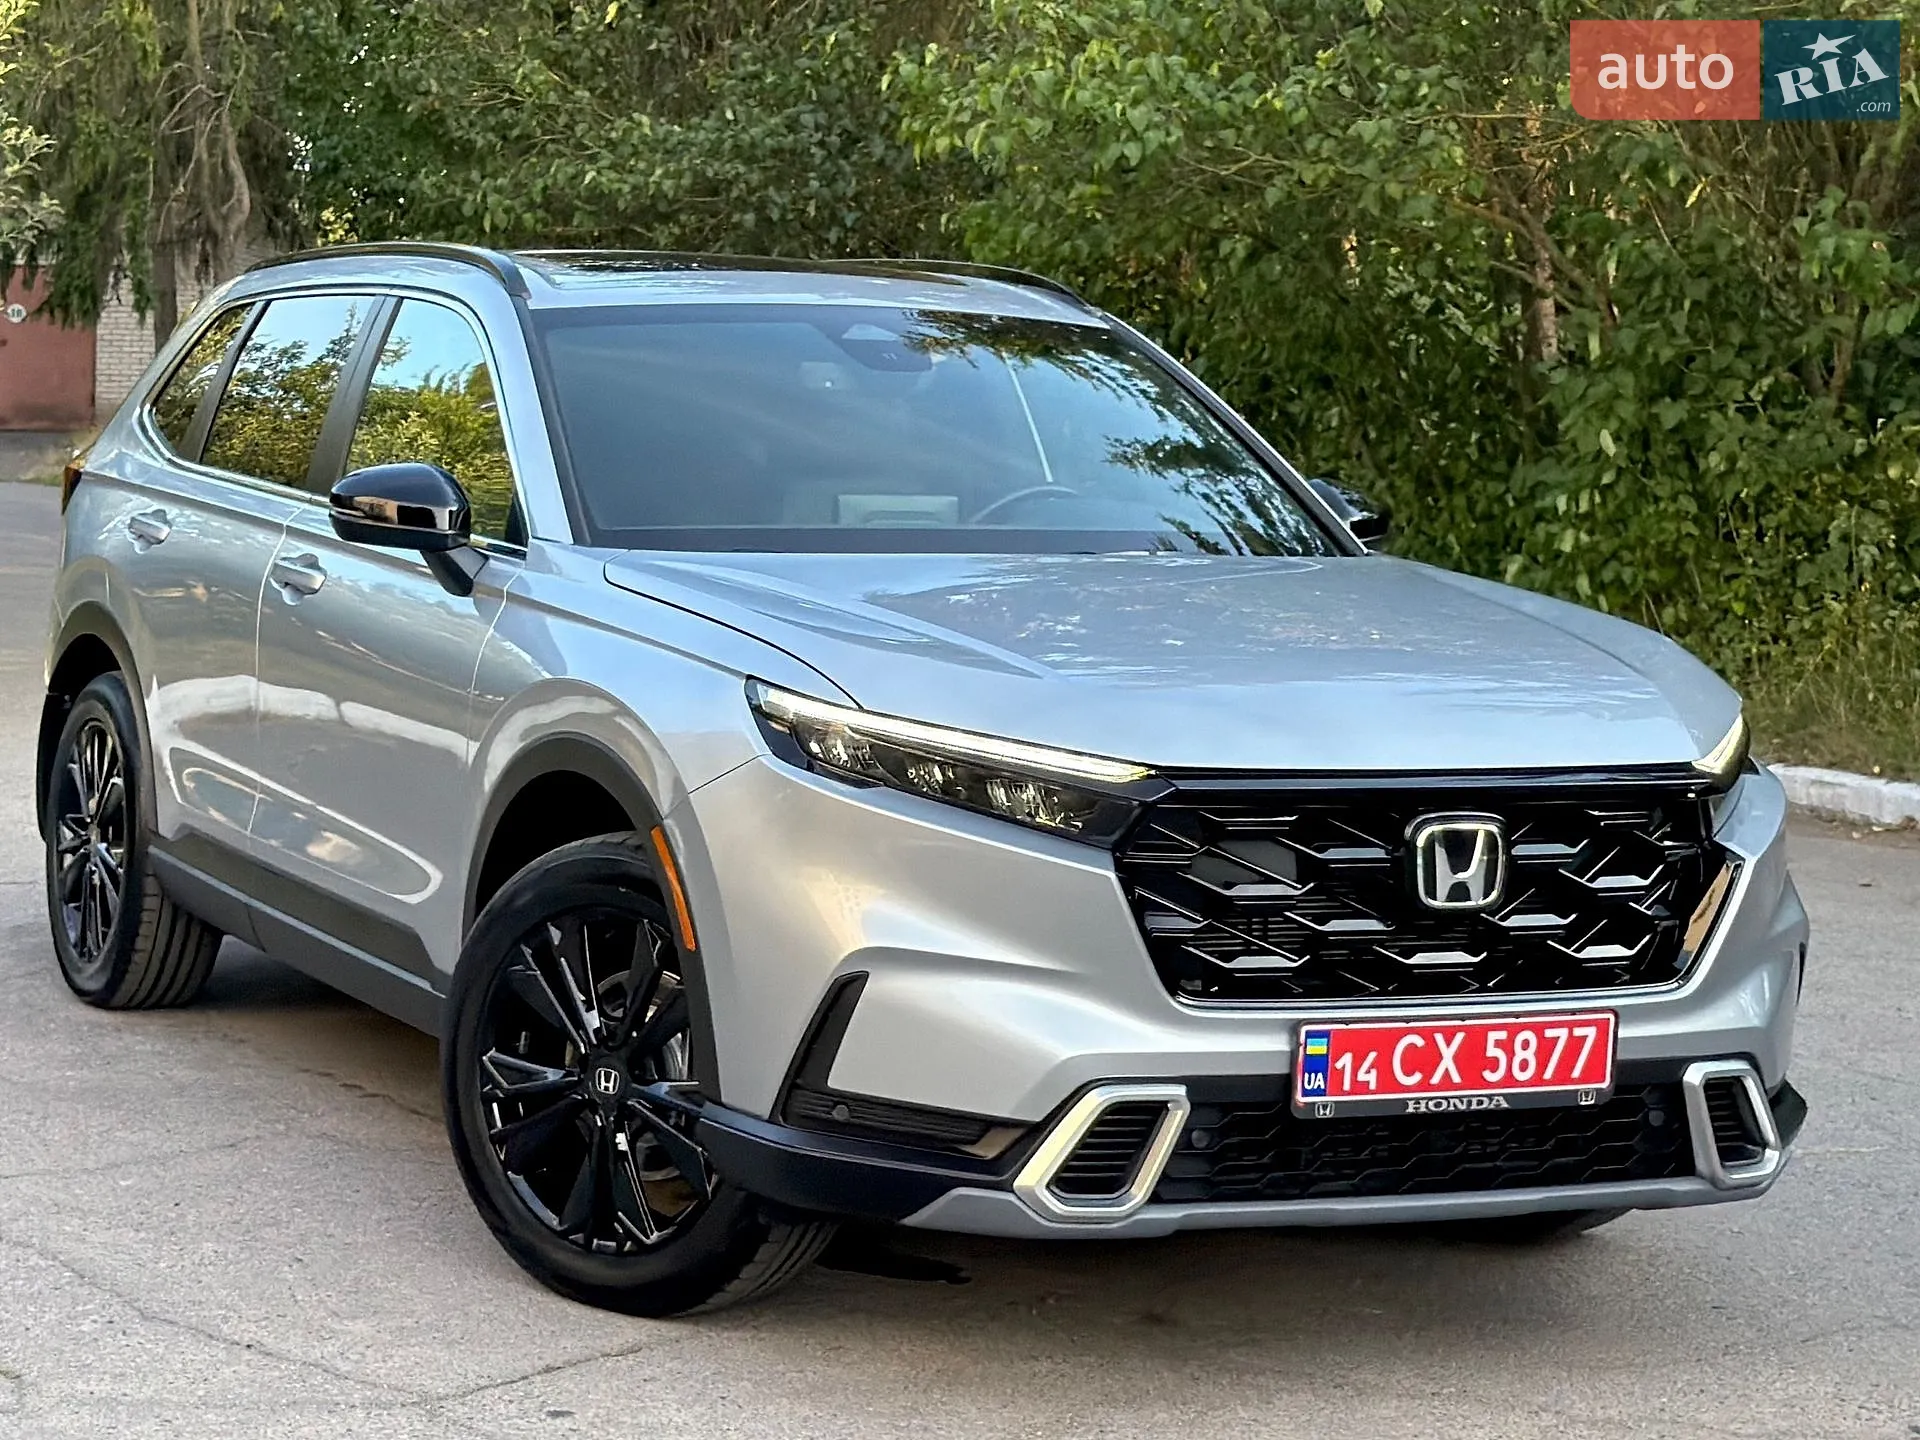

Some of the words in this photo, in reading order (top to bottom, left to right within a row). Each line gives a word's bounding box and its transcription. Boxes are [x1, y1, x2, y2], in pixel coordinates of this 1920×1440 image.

[1334, 1051, 1379, 1092] 14
[1392, 1031, 1466, 1086] CX
[1481, 1026, 1598, 1083] 5877
[1304, 1072, 1325, 1090] UA
[1405, 1095, 1512, 1114] HONDA
